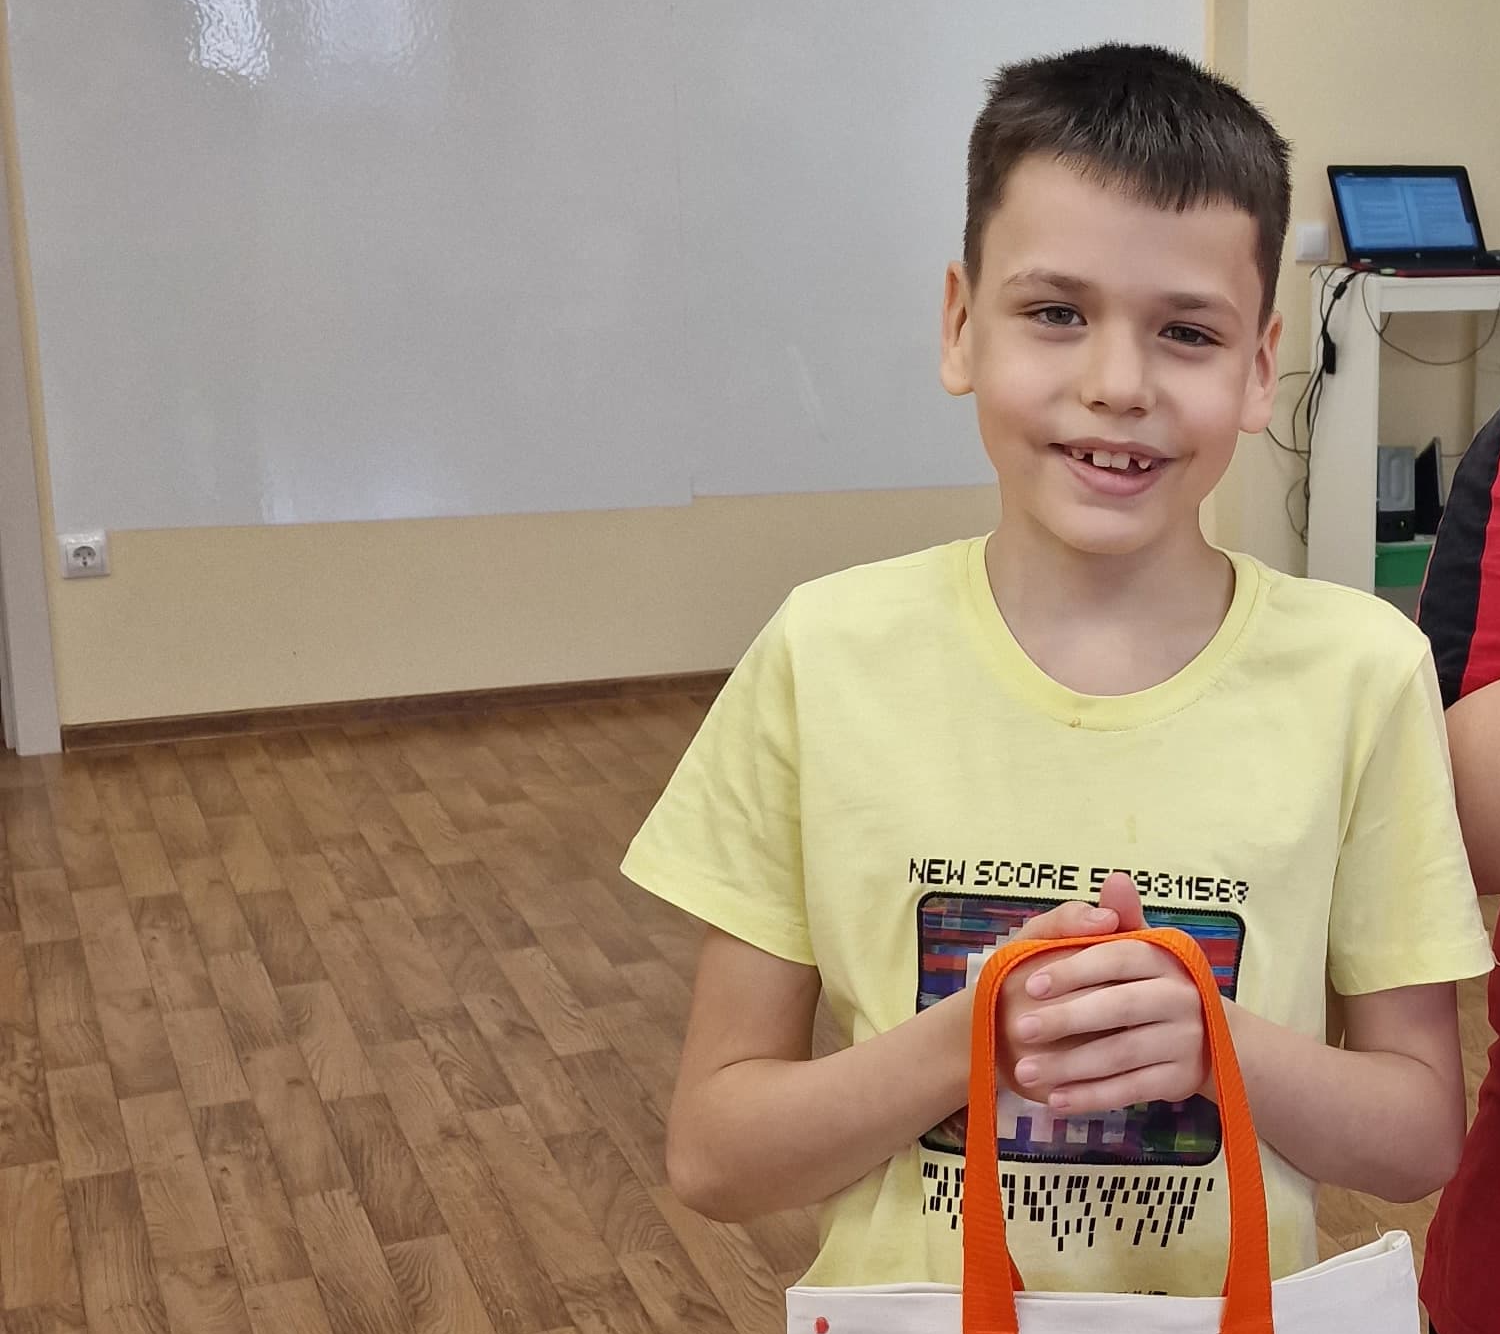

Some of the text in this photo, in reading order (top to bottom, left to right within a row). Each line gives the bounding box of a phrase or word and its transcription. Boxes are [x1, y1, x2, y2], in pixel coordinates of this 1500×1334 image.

[909, 858, 1249, 904] NEW SCORE 59311563
